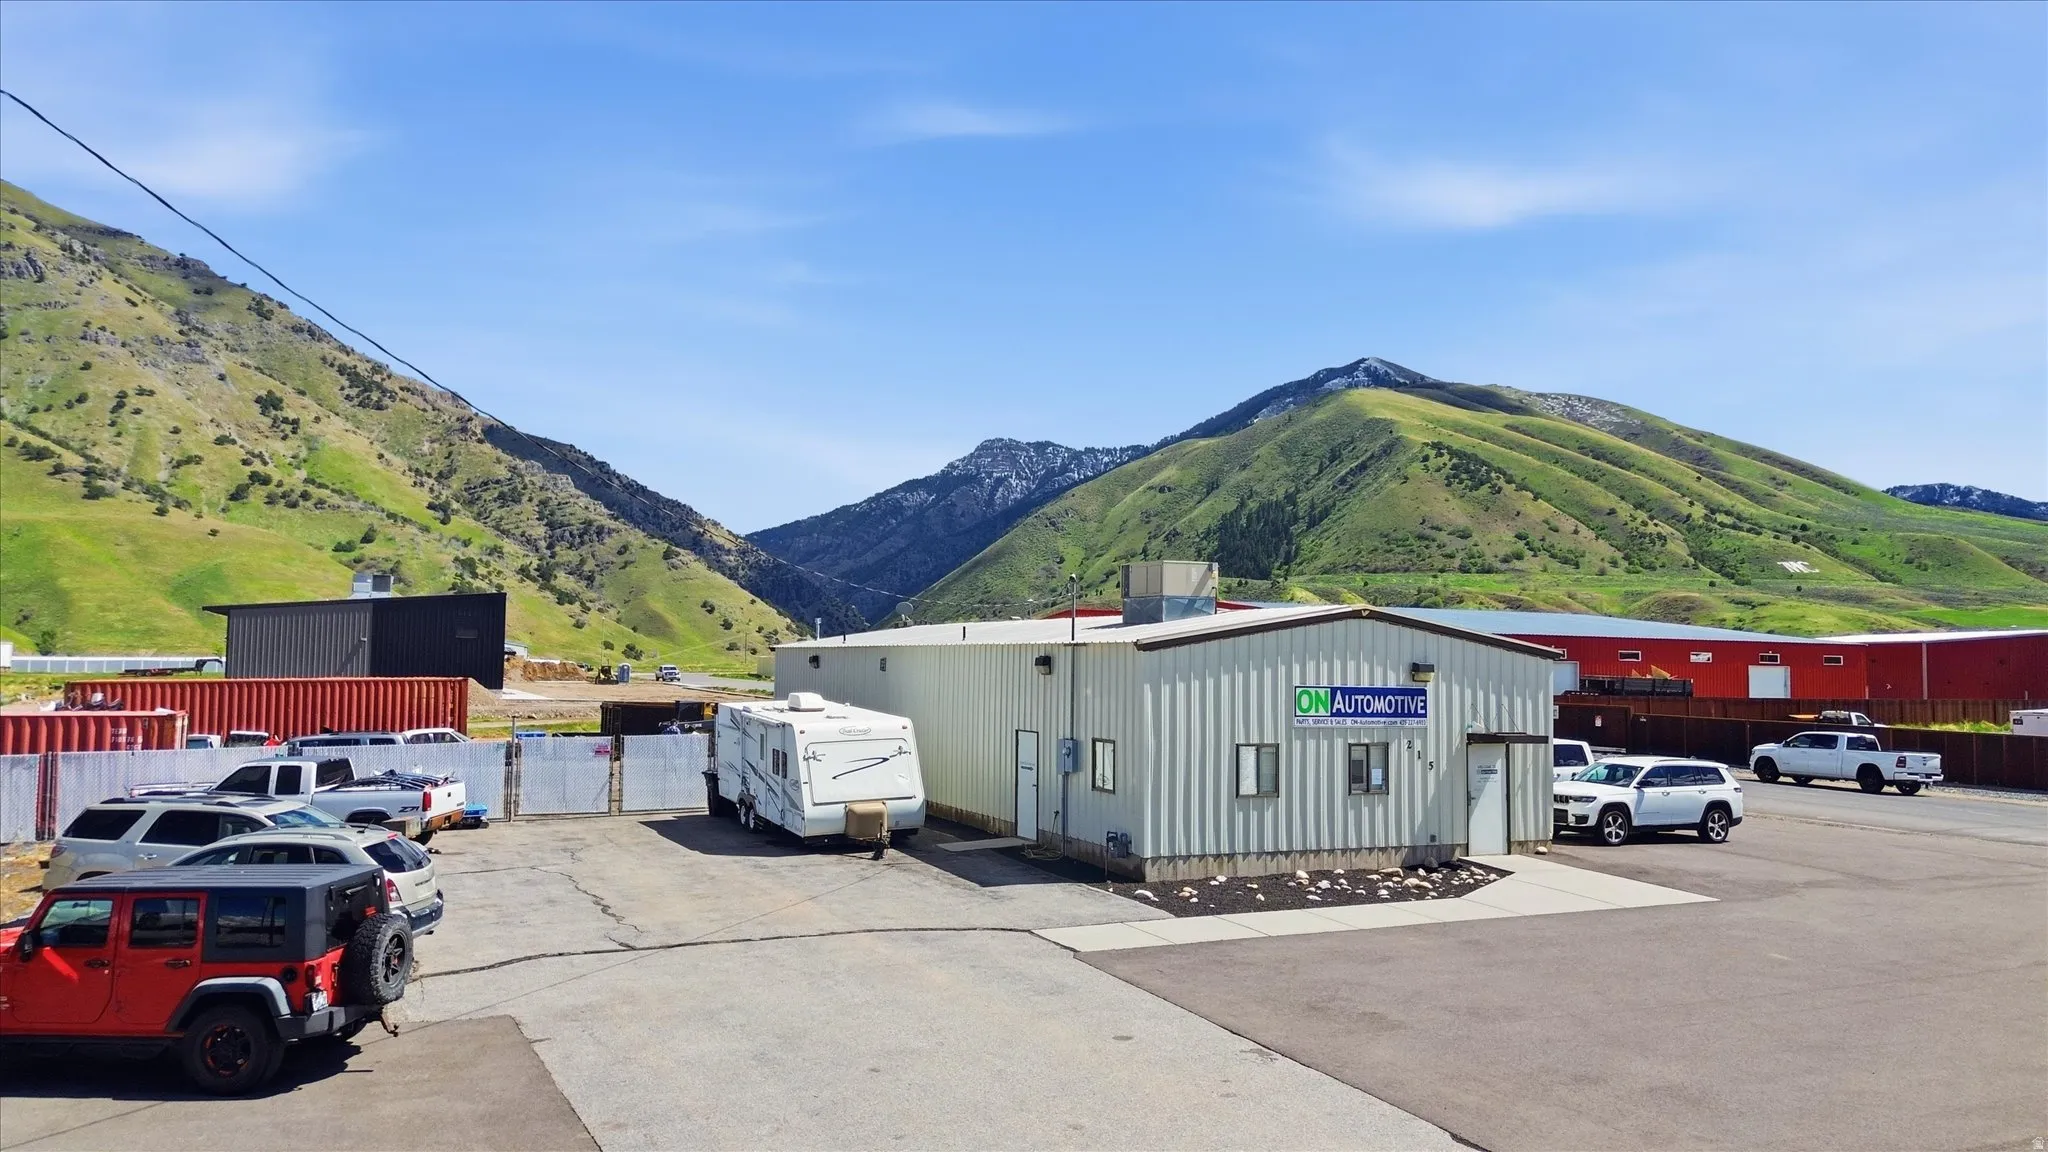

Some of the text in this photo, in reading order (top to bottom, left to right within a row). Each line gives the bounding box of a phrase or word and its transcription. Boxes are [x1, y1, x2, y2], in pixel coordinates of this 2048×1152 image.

[1297, 689, 1426, 714] ON AUTOMOTIVE
[1312, 718, 1329, 726] SERVICE
[1335, 718, 1348, 726] SALES
